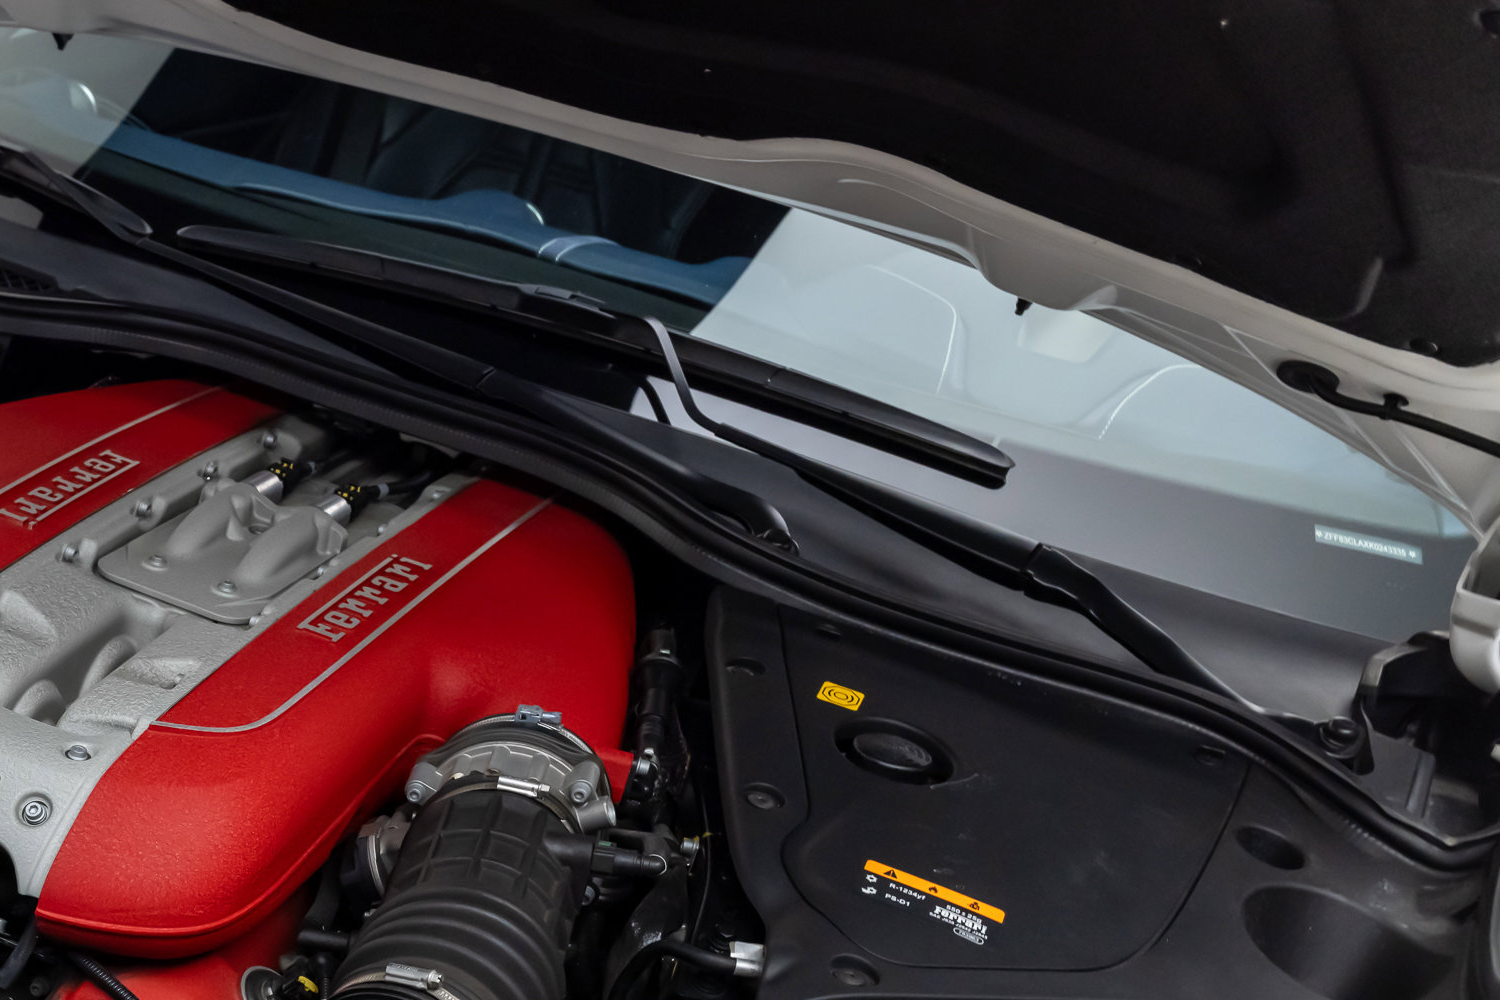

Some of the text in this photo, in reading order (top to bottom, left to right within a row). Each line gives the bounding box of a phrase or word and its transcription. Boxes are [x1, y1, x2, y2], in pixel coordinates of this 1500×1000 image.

[296, 553, 433, 643] Ferrari
[889, 882, 926, 901] R-1234yf
[933, 905, 988, 935] Ferrari
